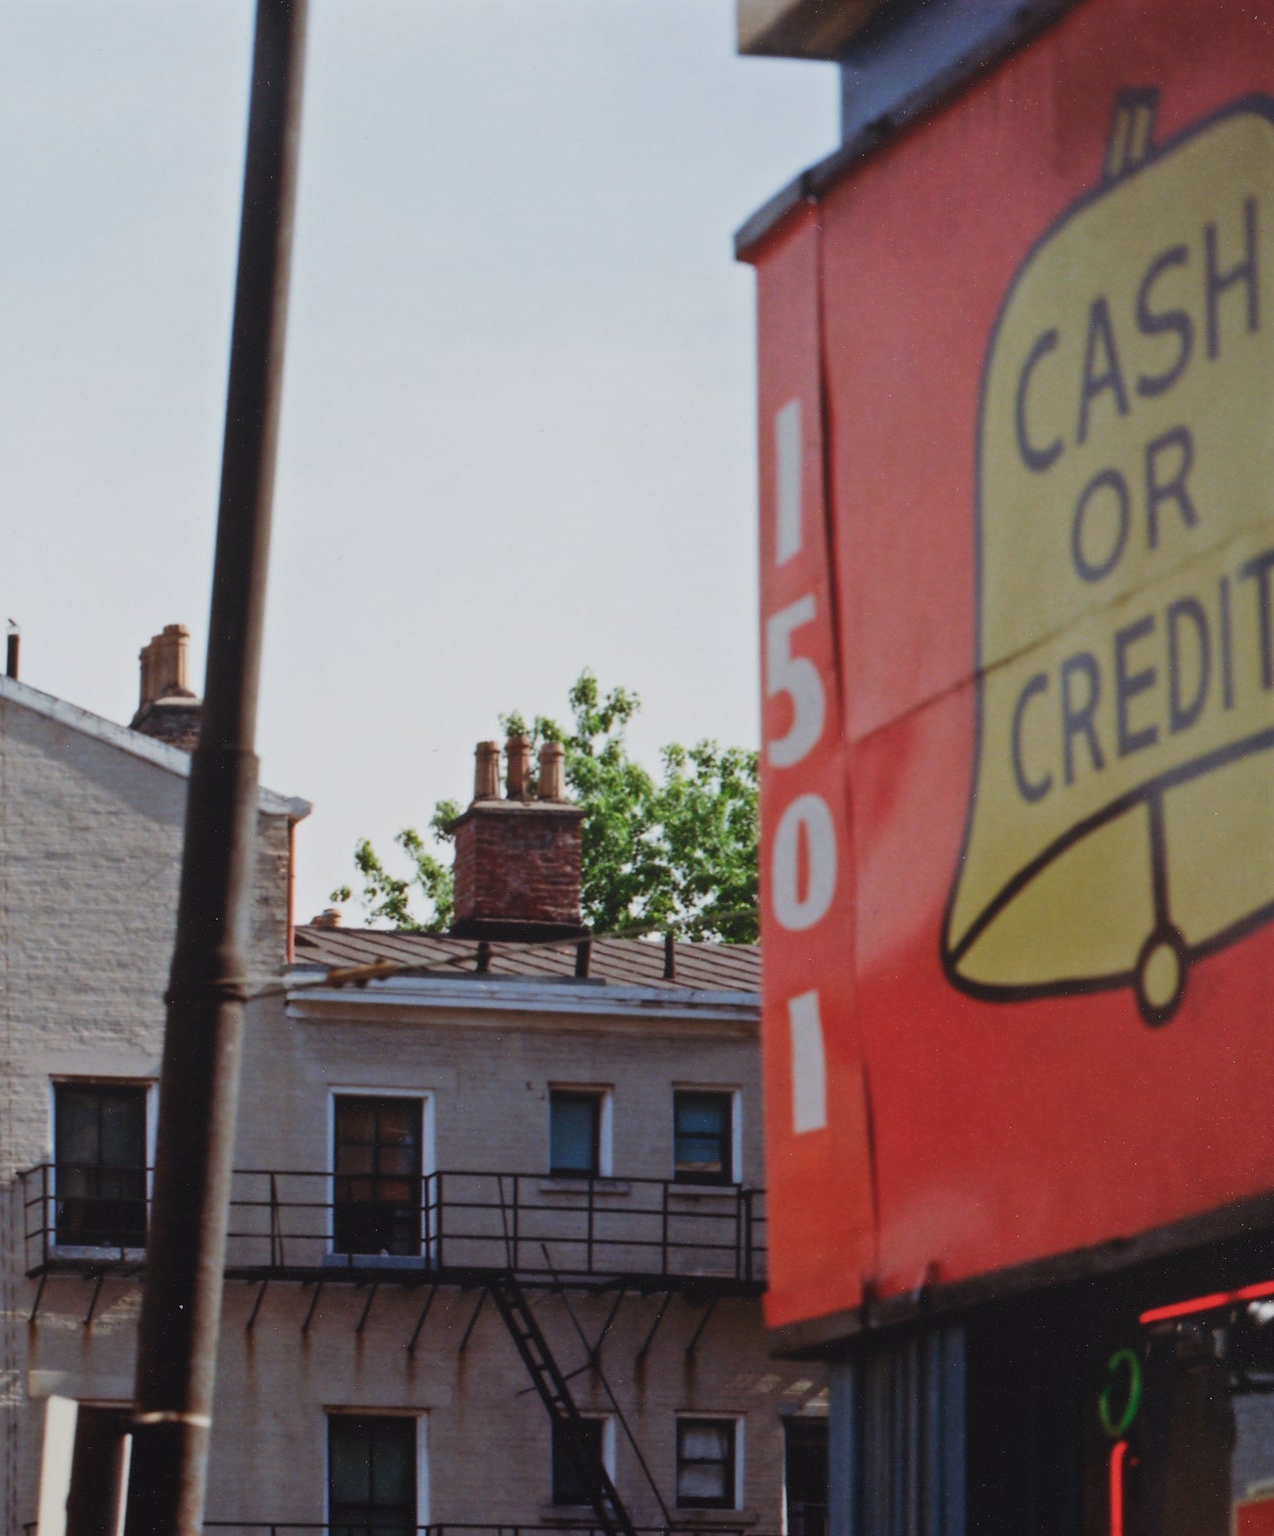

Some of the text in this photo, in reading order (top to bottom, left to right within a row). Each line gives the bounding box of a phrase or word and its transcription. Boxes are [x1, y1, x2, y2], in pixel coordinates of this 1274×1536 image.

[1016, 200, 1260, 472] CASH
[1072, 425, 1199, 583] OR
[766, 399, 838, 1135] 1501
[1010, 549, 1274, 803] CREDIT
